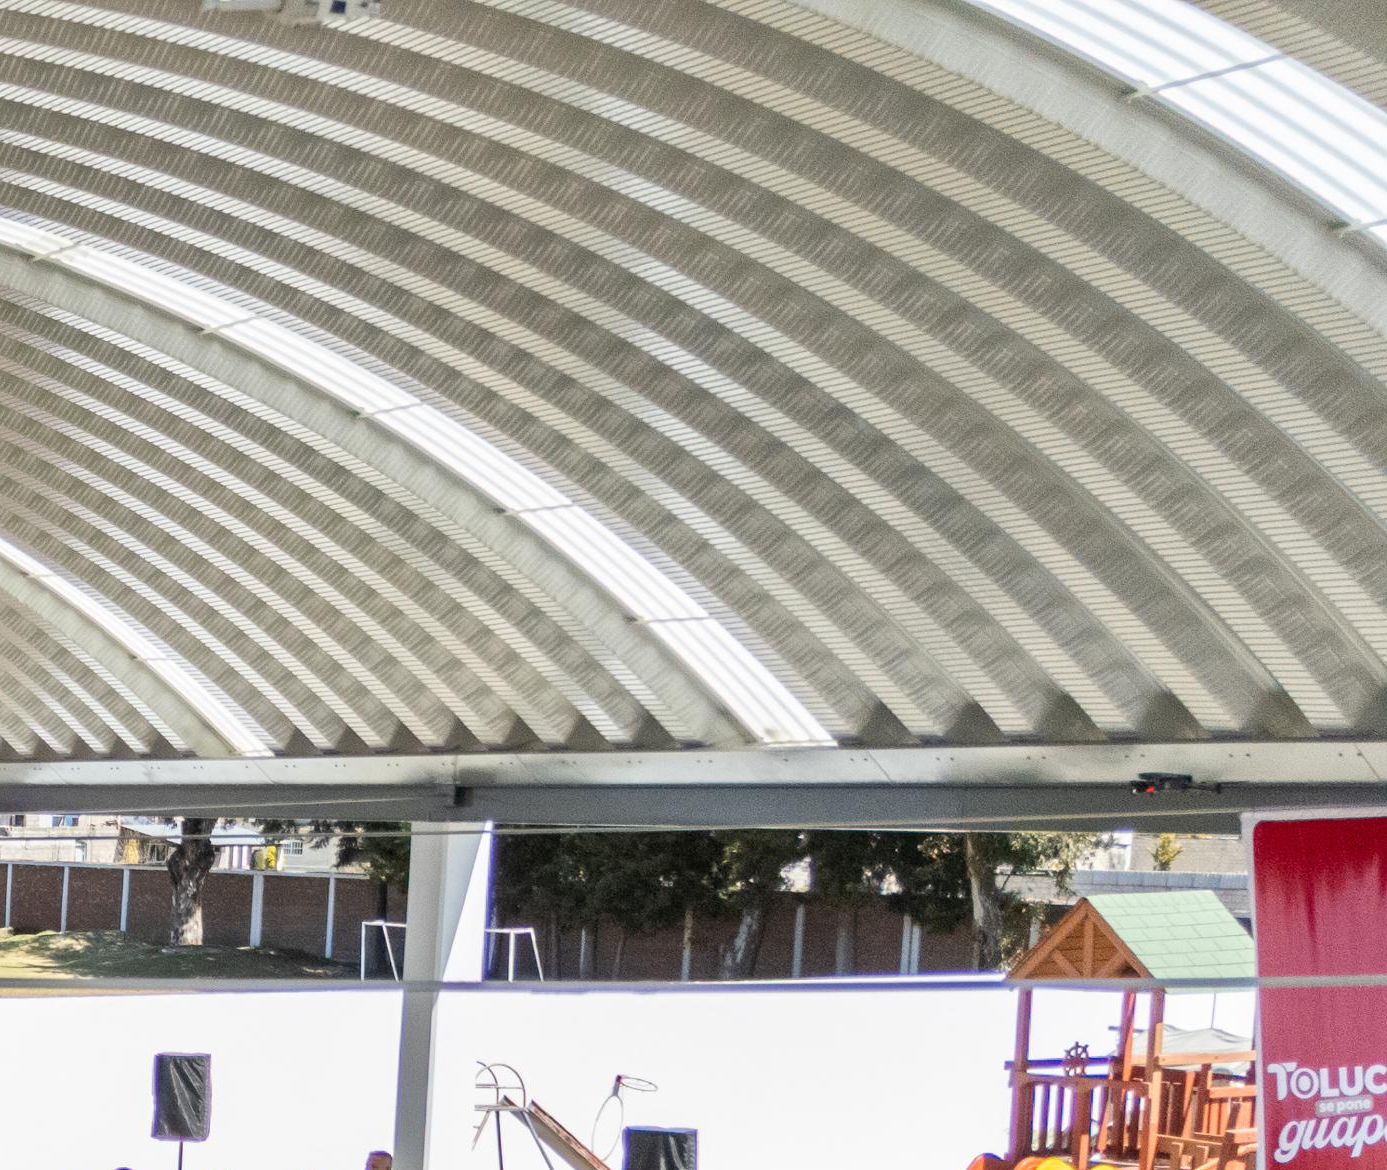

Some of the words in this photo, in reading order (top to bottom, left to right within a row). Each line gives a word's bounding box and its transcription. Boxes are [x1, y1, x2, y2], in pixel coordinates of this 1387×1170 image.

[1267, 1062, 1387, 1101] TOLUC
[1318, 1102, 1334, 1113] se
[1336, 1098, 1372, 1114] pone
[1274, 1114, 1387, 1164] guap
